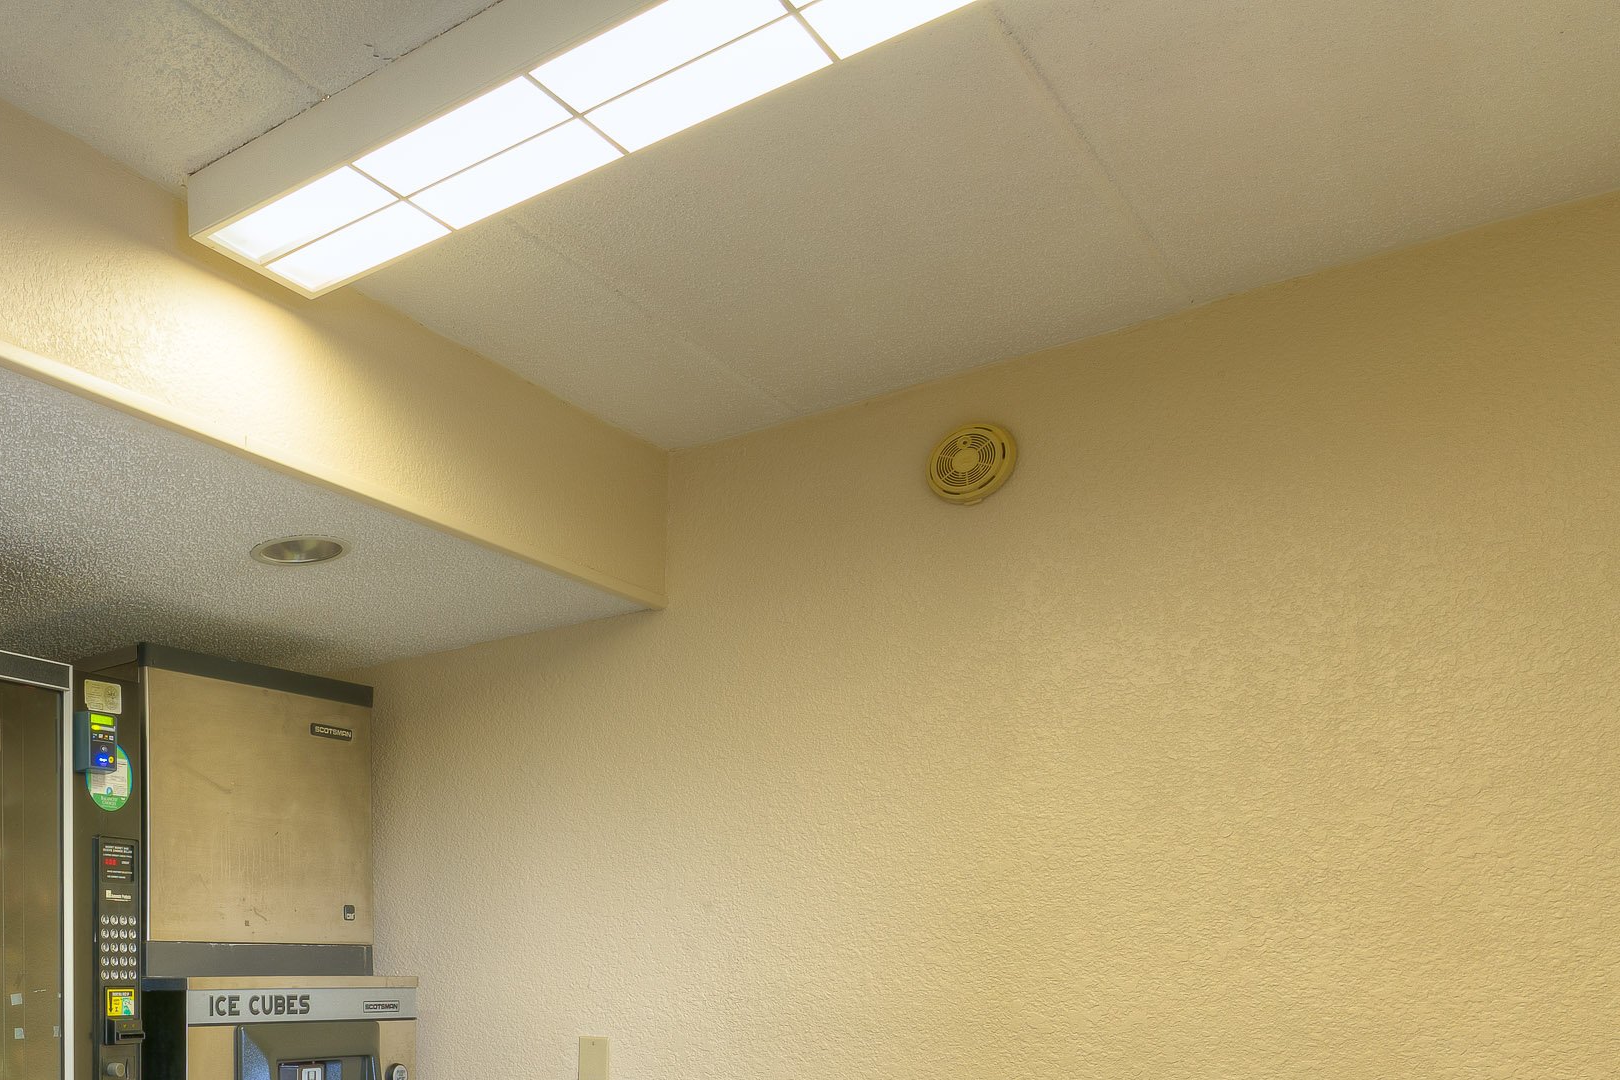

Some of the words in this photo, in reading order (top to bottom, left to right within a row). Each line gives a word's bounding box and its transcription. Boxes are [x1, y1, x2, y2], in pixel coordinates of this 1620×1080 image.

[313, 725, 353, 739] SCOTSMAN
[209, 995, 240, 1017] ICE
[248, 994, 311, 1016] CUBES
[364, 1002, 399, 1011] SCOTSMAN
